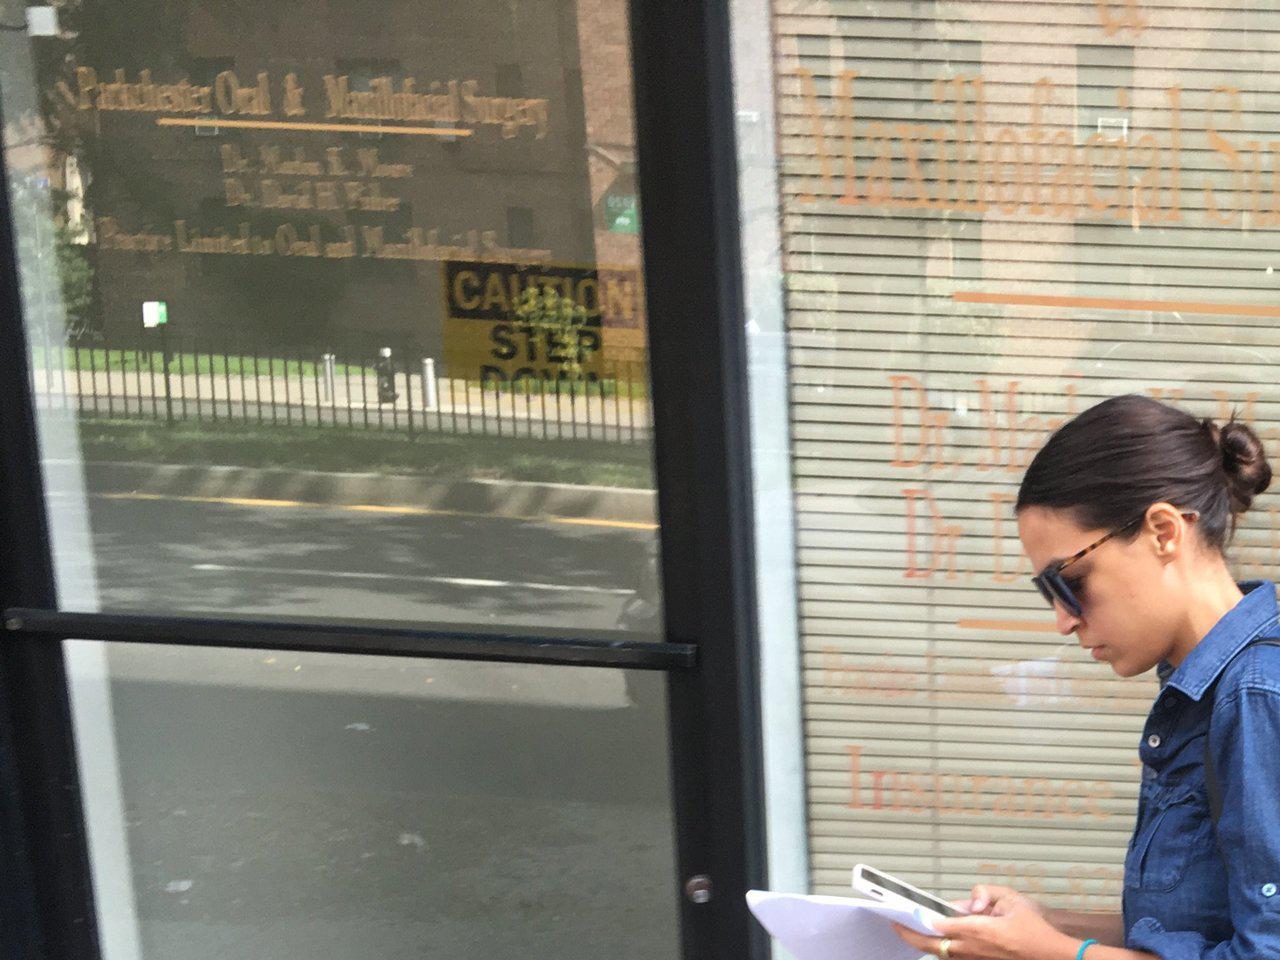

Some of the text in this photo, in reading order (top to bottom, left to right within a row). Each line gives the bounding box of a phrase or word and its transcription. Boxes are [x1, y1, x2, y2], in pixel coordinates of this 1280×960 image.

[793, 66, 1183, 222] Maxillofacial
[454, 268, 636, 322] CAUTION
[490, 323, 602, 364] STEP
[846, 744, 1115, 822] Insurance
